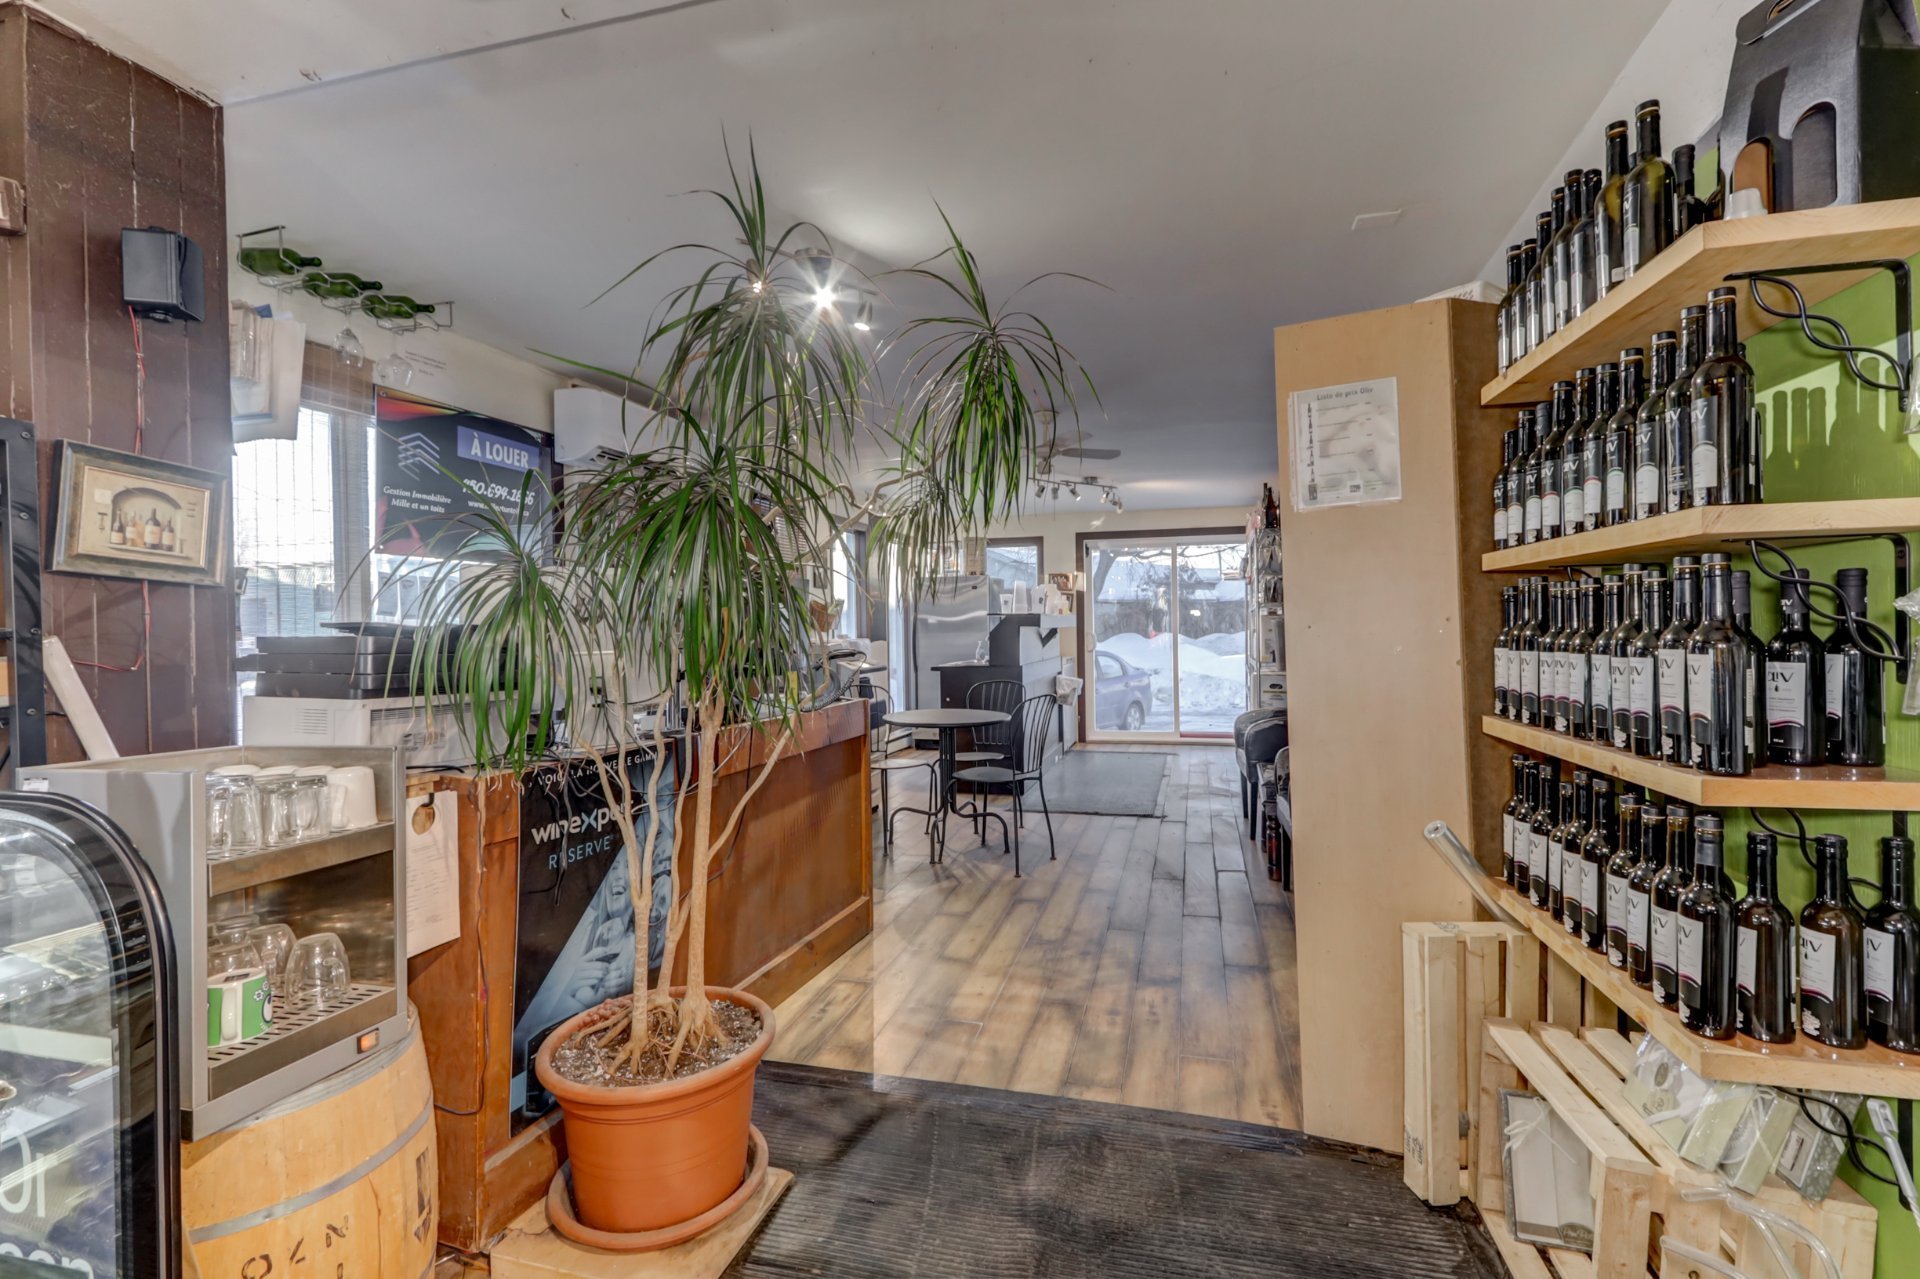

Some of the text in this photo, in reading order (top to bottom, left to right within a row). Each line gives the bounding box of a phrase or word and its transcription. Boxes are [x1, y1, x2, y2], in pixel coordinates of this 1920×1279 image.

[470, 432, 529, 468] À LOUER
[383, 486, 452, 504] Gestion Immobilière
[391, 498, 410, 509] Mille
[411, 502, 419, 510] et
[430, 503, 445, 513] toits
[537, 774, 565, 787] VOIC
[549, 835, 612, 870] RSERVE
